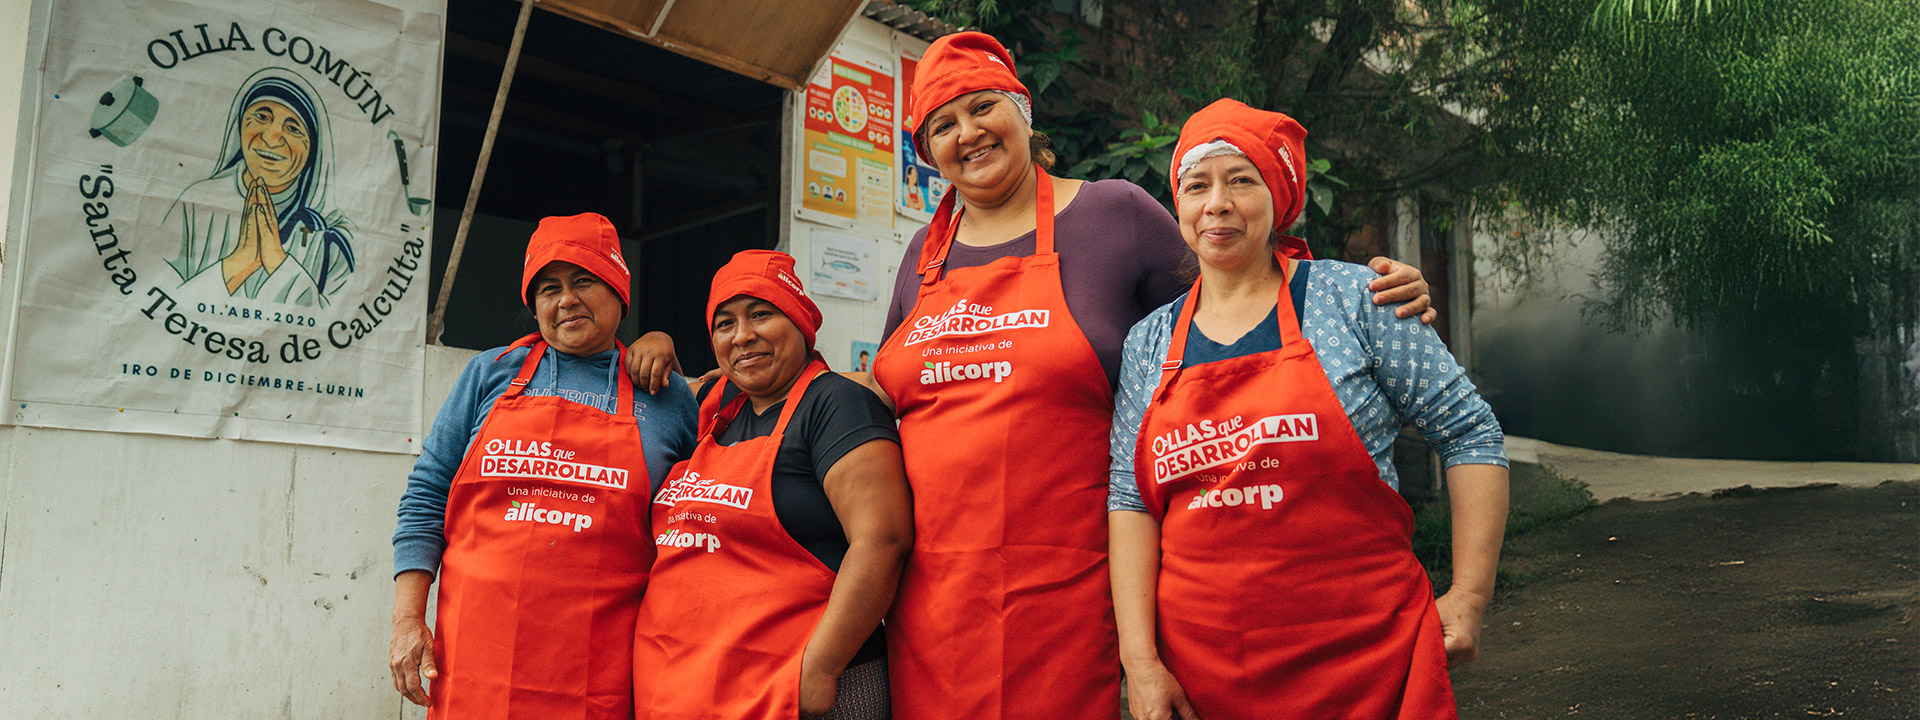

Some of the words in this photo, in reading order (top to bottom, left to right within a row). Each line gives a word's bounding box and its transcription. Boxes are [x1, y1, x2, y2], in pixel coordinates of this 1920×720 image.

[147, 21, 255, 69] OLLA
[262, 27, 395, 125] COMÚN
[79, 164, 137, 296] "Santa
[140, 286, 270, 364] Teresa
[279, 333, 321, 364] de
[197, 302, 317, 328] 01.ABR.2020
[906, 310, 1049, 346] DESARROLLAN
[913, 298, 968, 330] OLLAS
[968, 301, 993, 317] que
[921, 347, 943, 358] Una
[945, 343, 995, 355] iniciativa
[997, 339, 1013, 349] de
[122, 363, 158, 377] 1RO
[170, 367, 192, 380] DE
[204, 371, 365, 399] DICIEMBRE-LURIN
[919, 360, 1013, 385] alicorp
[485, 438, 552, 457] OLLAS
[553, 448, 576, 462] que
[1151, 419, 1217, 457] OLLAS
[1217, 415, 1244, 437] que
[1156, 415, 1317, 482] DESARROLLAN
[482, 457, 627, 488] DESARROLLAN
[1195, 473, 1217, 483] Una
[1260, 456, 1280, 469] de
[507, 486, 529, 498] Una
[531, 486, 579, 502] iniciativa
[581, 493, 596, 504] de
[503, 500, 593, 533] alicorp
[704, 512, 717, 524] de
[655, 528, 722, 553] alicorp
